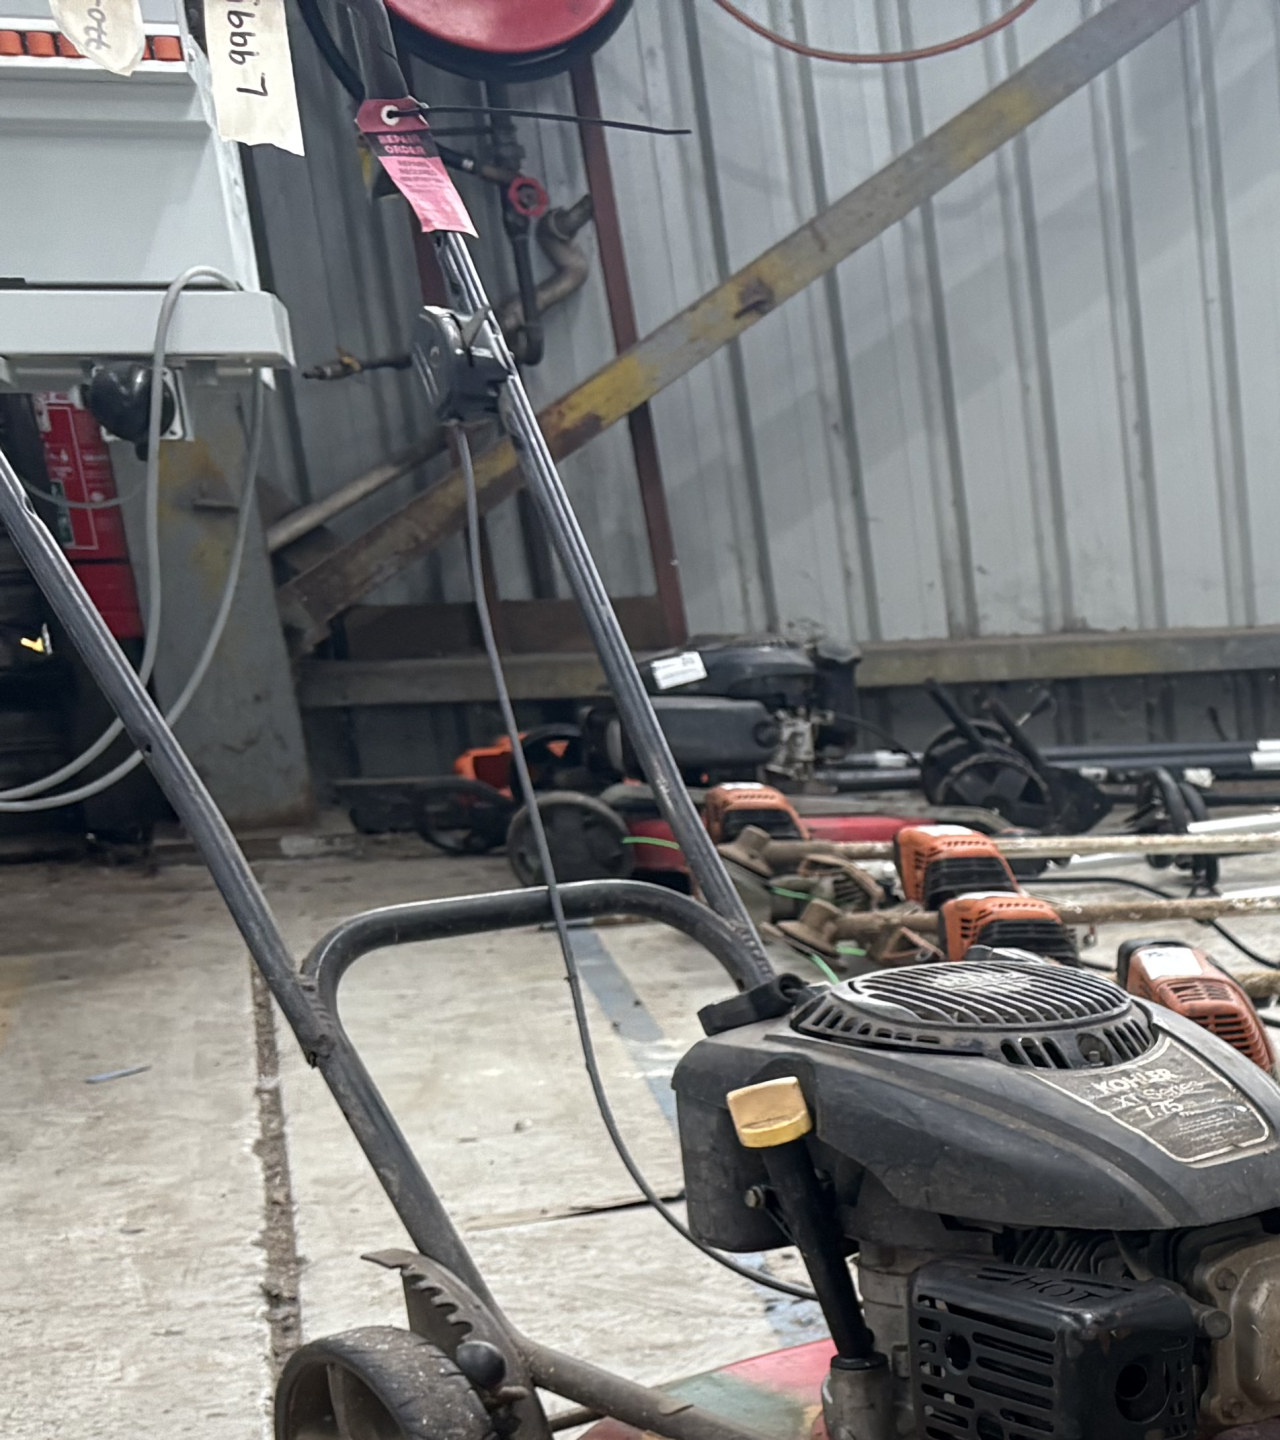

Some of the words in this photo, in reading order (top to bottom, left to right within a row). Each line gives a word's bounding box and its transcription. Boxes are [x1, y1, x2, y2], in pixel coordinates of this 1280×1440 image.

[1091, 1068, 1181, 1097] KOHLER
[1135, 1099, 1185, 1120] 7.75
[1011, 1274, 1105, 1304] HOT
